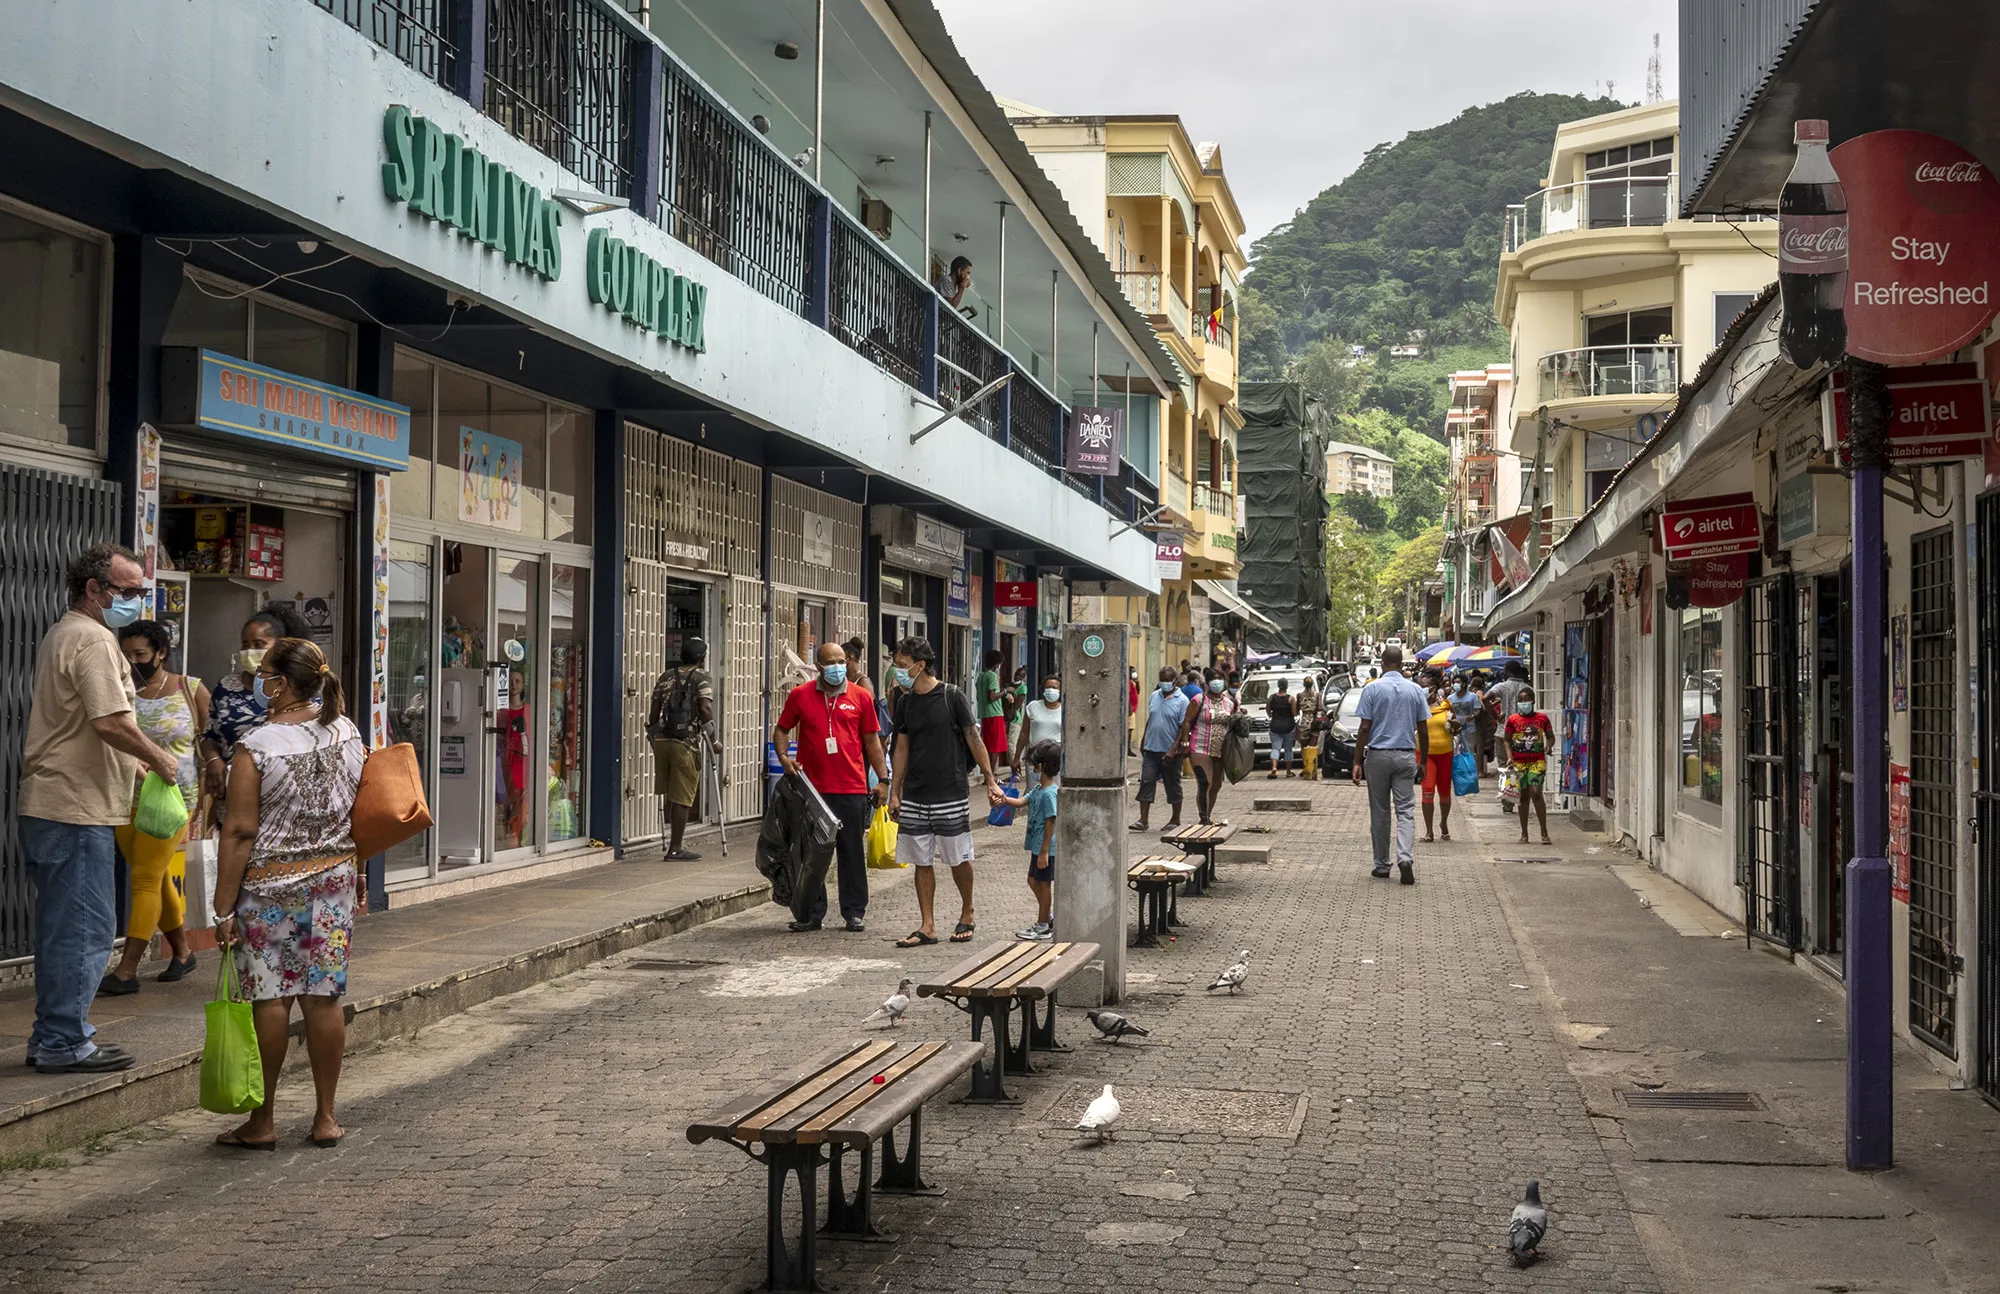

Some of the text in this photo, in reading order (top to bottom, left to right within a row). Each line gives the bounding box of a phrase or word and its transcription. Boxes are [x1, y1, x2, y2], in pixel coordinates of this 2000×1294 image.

[1915, 161, 1982, 183] Coca-Cola
[382, 104, 708, 354] SRINIVAS COMPLEX
[1784, 225, 1847, 253] Coca-Cola
[1891, 236, 1950, 266] Stay
[1854, 281, 1988, 306] Refreshed
[518, 350, 525, 371] 7
[219, 369, 399, 442] SRI MAHA VISHNU
[1900, 401, 1958, 424] airtel
[259, 412, 365, 451] SNACK BOX
[701, 422, 706, 440] 6
[1890, 446, 1921, 457] ilable
[1699, 517, 1734, 533] airtel
[686, 544, 709, 562] HEALTHY
[1158, 545, 1182, 556] FLO
[1691, 544, 1740, 556] available here!
[1706, 562, 1729, 574] Stay
[1692, 578, 1743, 589] Refreshed
